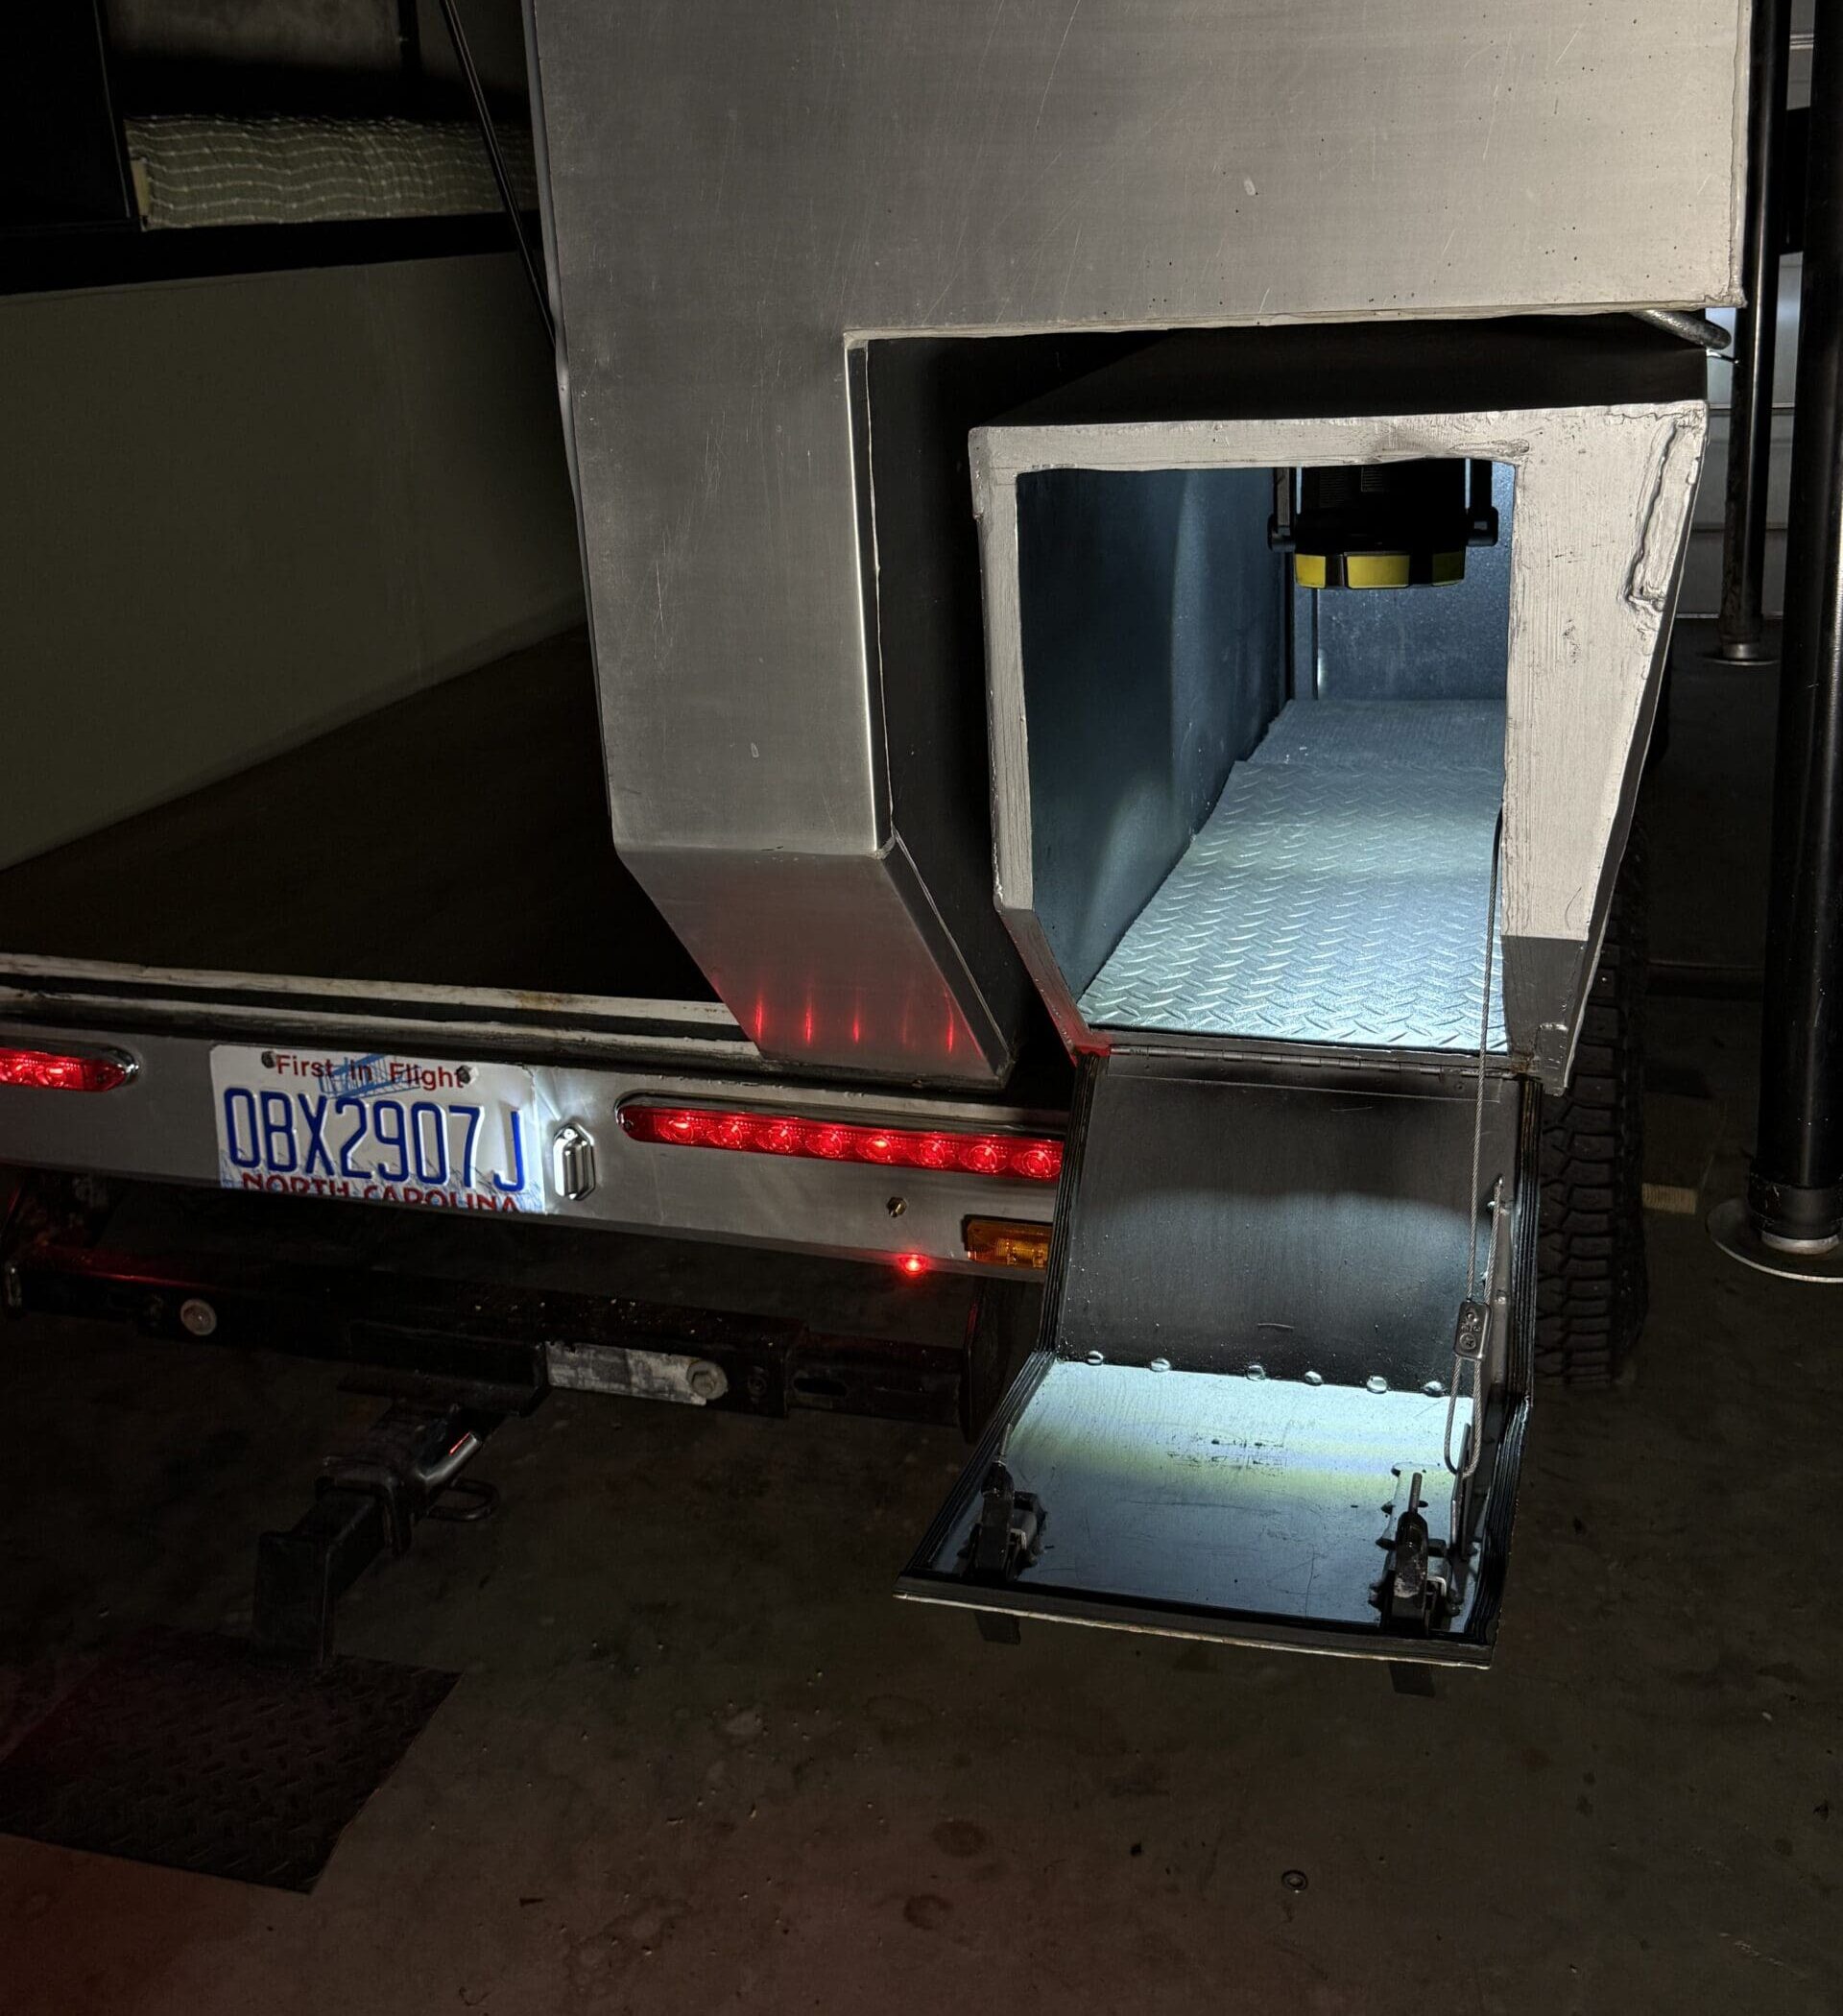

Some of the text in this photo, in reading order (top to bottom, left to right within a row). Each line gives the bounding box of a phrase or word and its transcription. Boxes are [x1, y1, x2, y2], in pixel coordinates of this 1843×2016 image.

[275, 1054, 464, 1092] First In Flight
